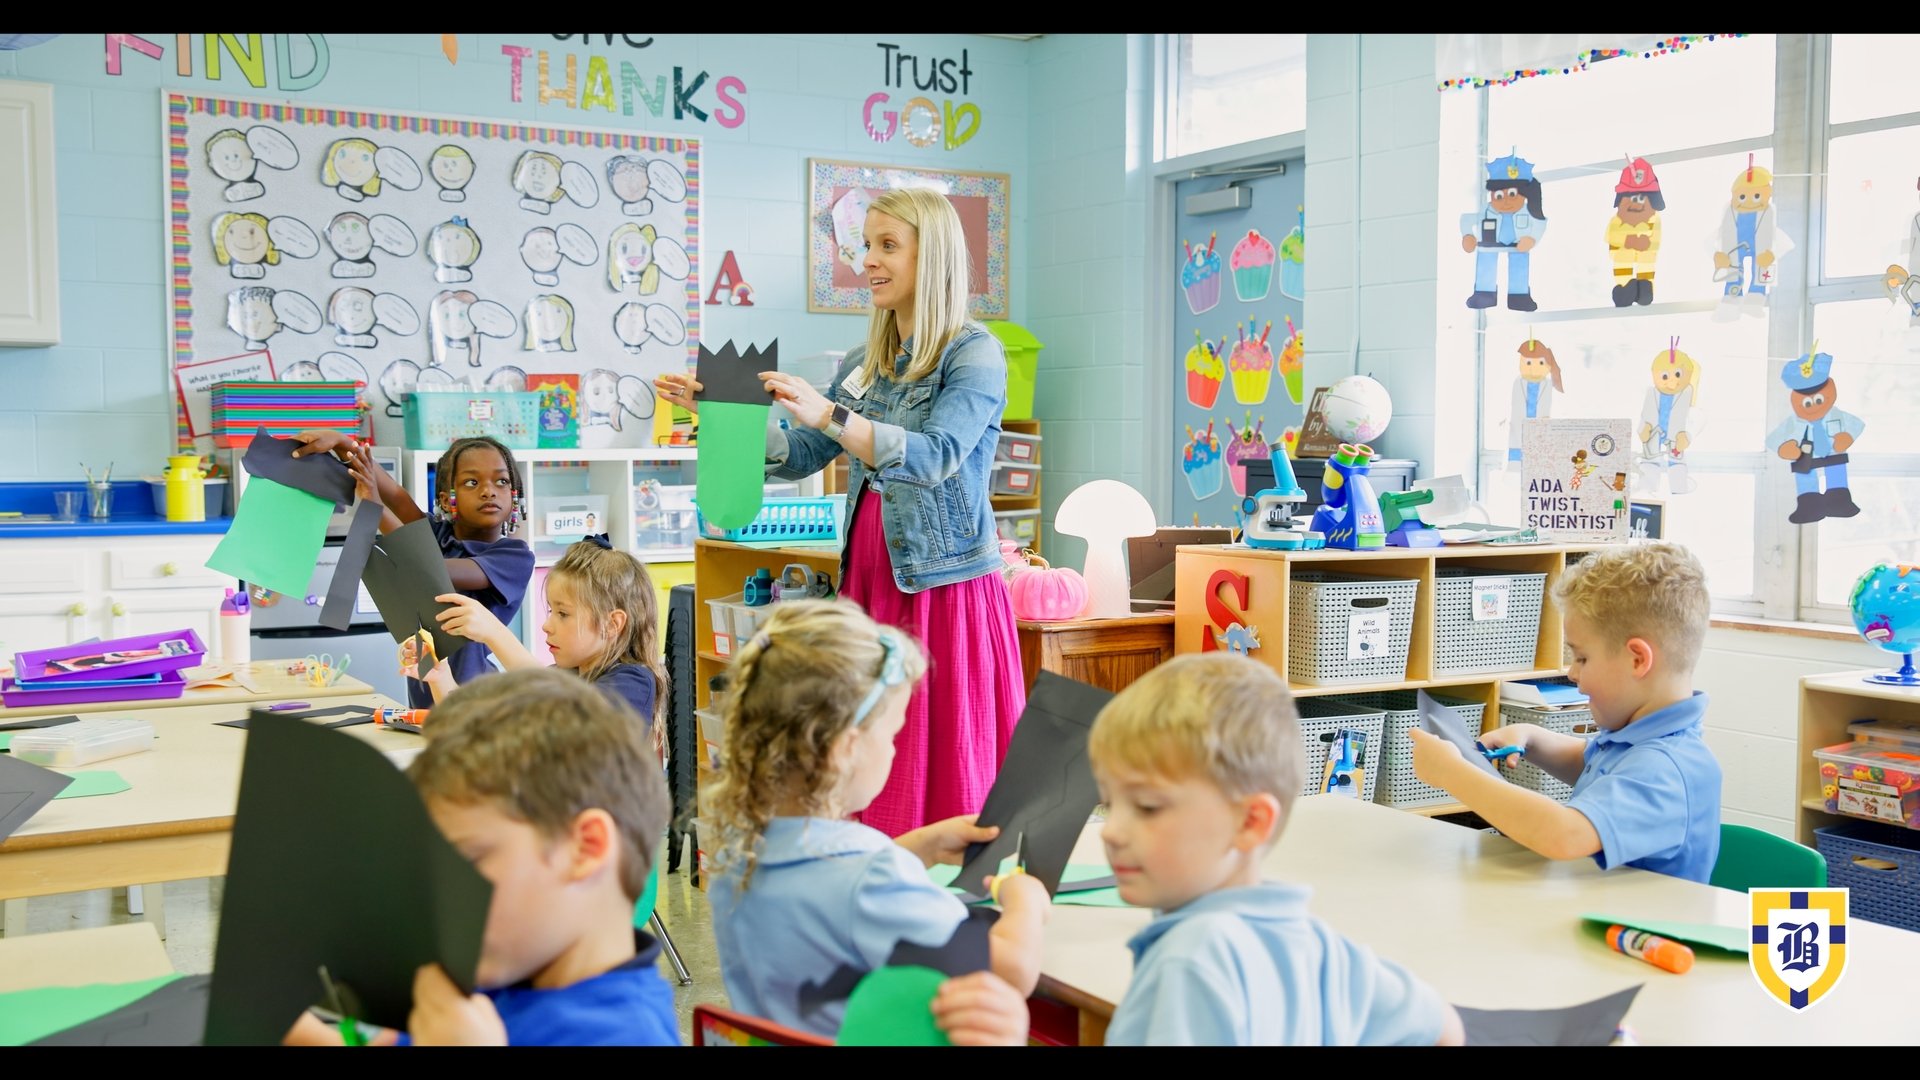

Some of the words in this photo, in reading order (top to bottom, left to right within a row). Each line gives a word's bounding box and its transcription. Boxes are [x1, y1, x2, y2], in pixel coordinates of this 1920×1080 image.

[501, 44, 747, 129] THANKS
[877, 43, 973, 95] Trust
[862, 91, 981, 151] GOD
[704, 250, 754, 306] A
[1529, 478, 1563, 493] ADA
[554, 516, 583, 530] girls
[1528, 514, 1616, 530] SCIENTIST
[1201, 569, 1250, 653] S
